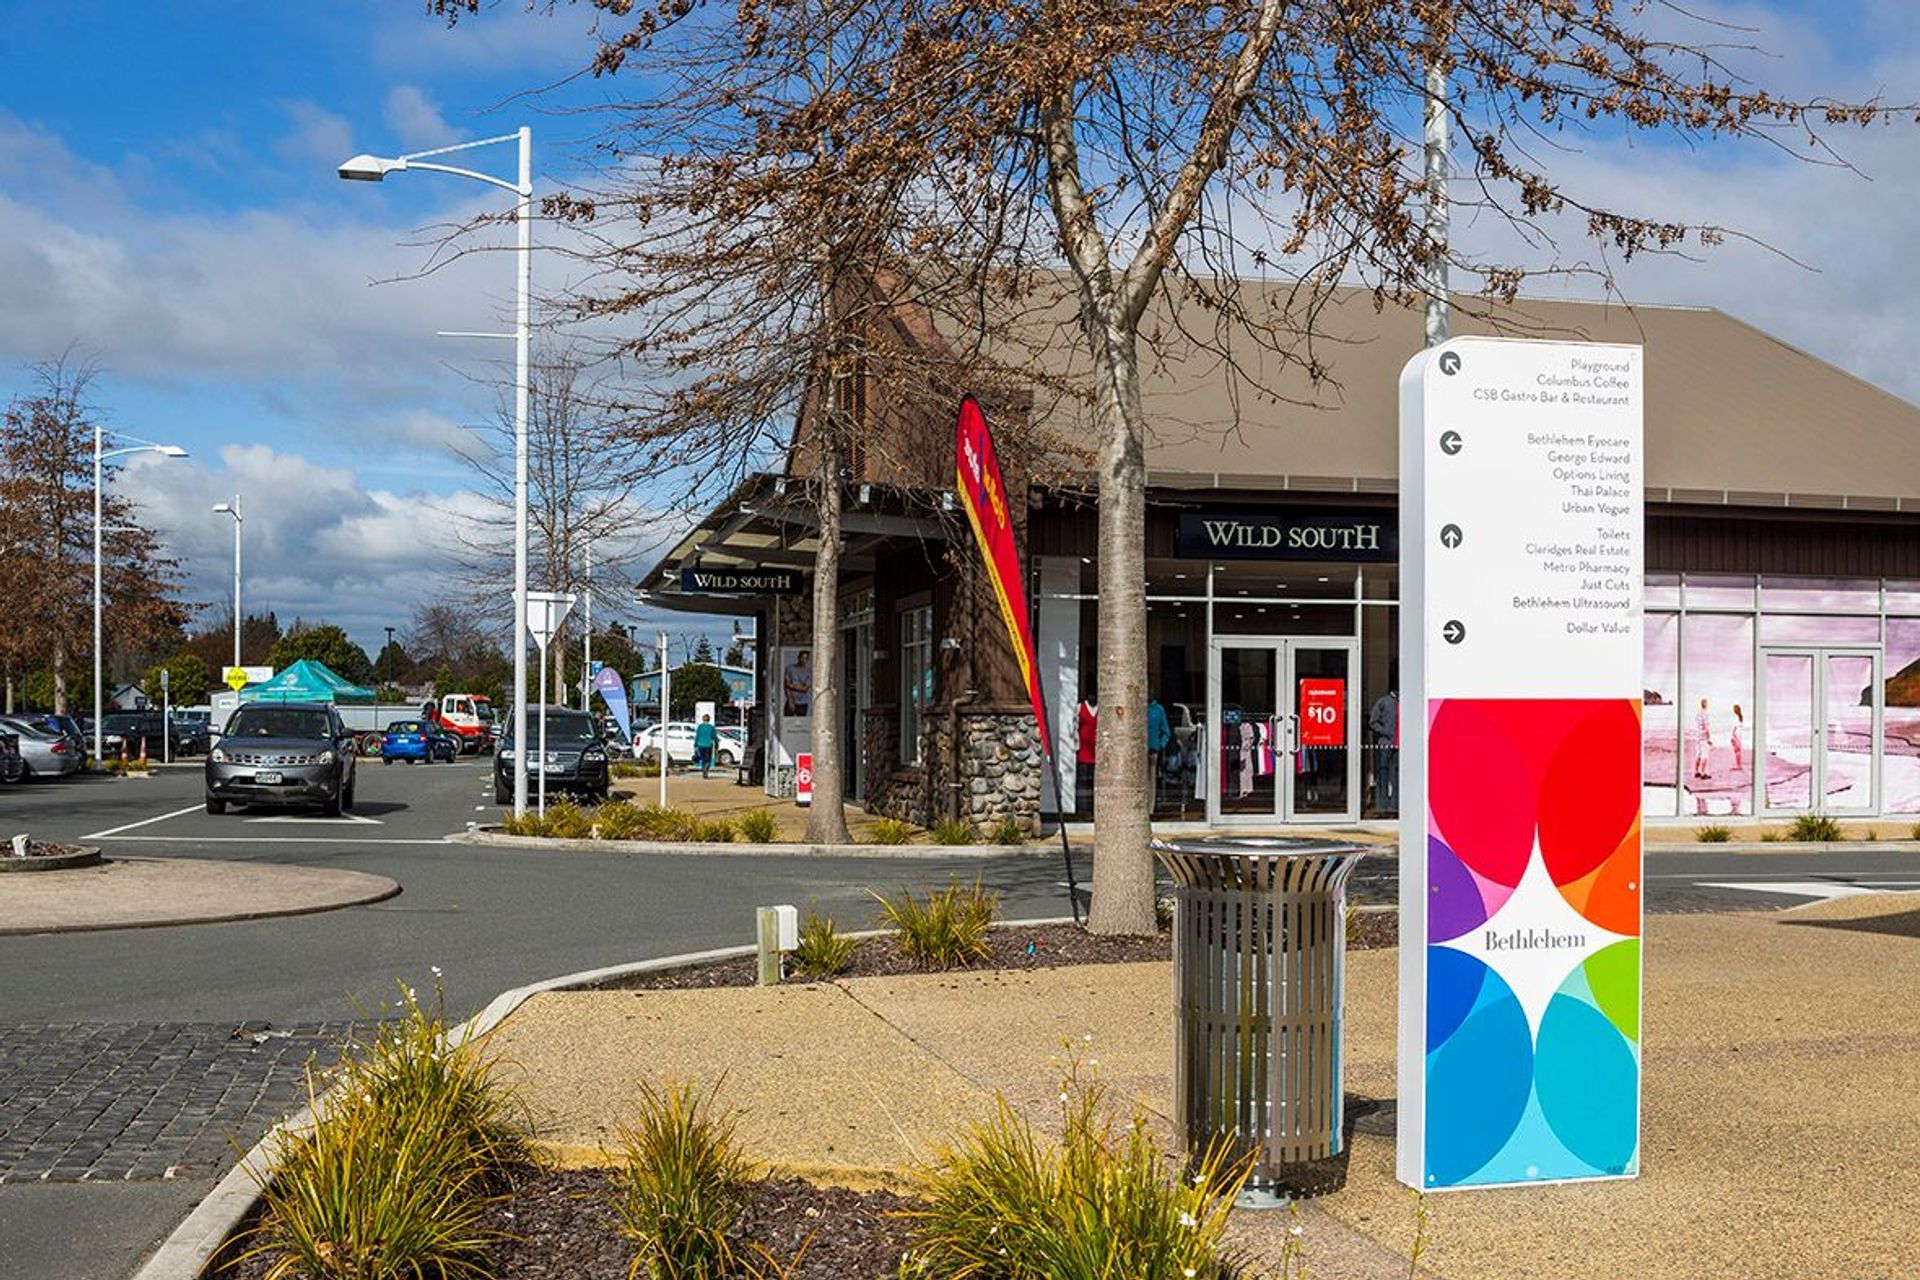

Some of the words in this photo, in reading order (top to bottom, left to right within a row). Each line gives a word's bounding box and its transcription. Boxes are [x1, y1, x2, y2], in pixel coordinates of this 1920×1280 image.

[1571, 358, 1630, 373] Playground
[1536, 373, 1590, 386] Columbus
[1593, 377, 1630, 389] Coffee
[1473, 388, 1498, 401] CSB
[1500, 389, 1538, 402] Gastro
[1540, 391, 1558, 403] Bar
[1561, 392, 1570, 403] &
[1572, 393, 1630, 405] Restaurant
[1527, 433, 1585, 446] Bethlehem
[1587, 434, 1630, 448] Eyecare
[1547, 450, 1587, 466] George
[1589, 452, 1630, 465] Edward
[1552, 467, 1597, 482] Options
[1599, 470, 1630, 484] Living
[1570, 485, 1594, 497] Thai
[1595, 486, 1630, 498] Palace
[1562, 502, 1595, 514] Urban
[1597, 504, 1630, 517] Vogue
[1597, 527, 1630, 541] Toilets
[1525, 543, 1573, 557] Claridges
[1574, 545, 1597, 556] Real
[1599, 545, 1630, 557] Estate
[1543, 561, 1577, 573] Metro
[1579, 561, 1630, 576] Pharmacy
[1580, 579, 1602, 590] Just
[1604, 578, 1630, 591] Cuts
[1512, 596, 1571, 609] Bethlehem
[1572, 597, 1631, 610] Ultrasound
[1566, 621, 1599, 634] Dollar
[1601, 622, 1630, 634] Value
[1308, 706, 1336, 723] $10
[1485, 928, 1586, 951] Bethlehem
